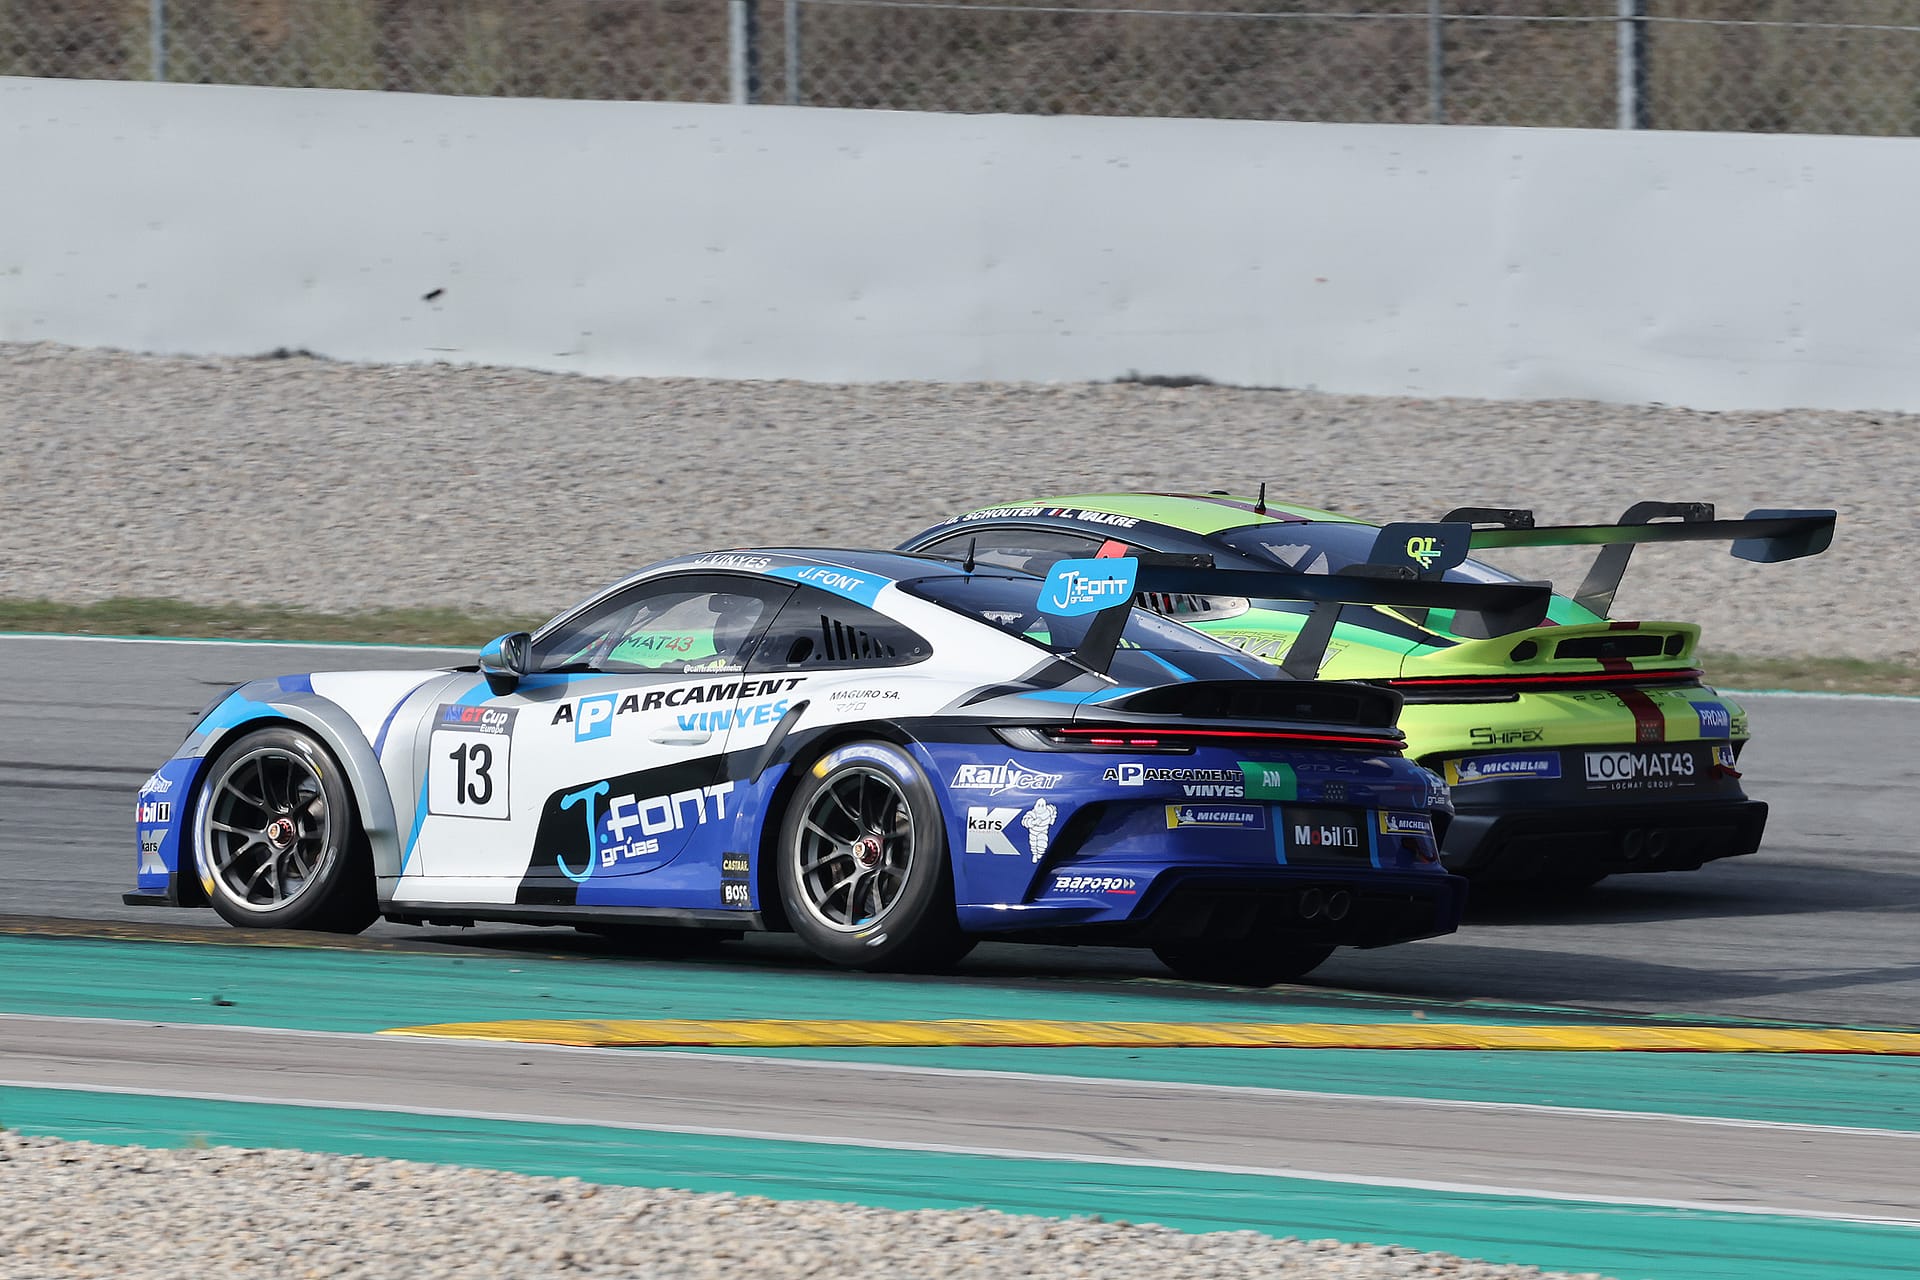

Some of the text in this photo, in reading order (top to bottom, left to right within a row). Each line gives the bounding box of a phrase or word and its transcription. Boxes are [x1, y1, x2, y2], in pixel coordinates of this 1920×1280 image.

[963, 507, 1044, 522] SCHOUTEN
[1077, 510, 1140, 528] VALKRE
[694, 554, 771, 569] J.VINYES
[797, 567, 865, 592] J.FONT
[829, 690, 881, 701] MAGURO
[677, 699, 789, 732] VINYES
[1700, 709, 1728, 726] PROAM
[480, 724, 504, 734] Europe
[449, 742, 493, 805] 13
[1482, 760, 1549, 773] MICHELIN
[1585, 752, 1695, 780] LOCMAT43
[956, 763, 1063, 790] Rallycar
[1262, 770, 1281, 788] AM
[1183, 785, 1244, 797] VINYES
[1611, 781, 1673, 790] LOCMAT GROUP
[968, 816, 1003, 831] kars
[1197, 811, 1254, 822] MICHELIN
[1399, 819, 1430, 831] MICHELIN
[1294, 825, 1341, 846] Mobil
[601, 836, 660, 867] grúas
[725, 885, 748, 901] BOSS
